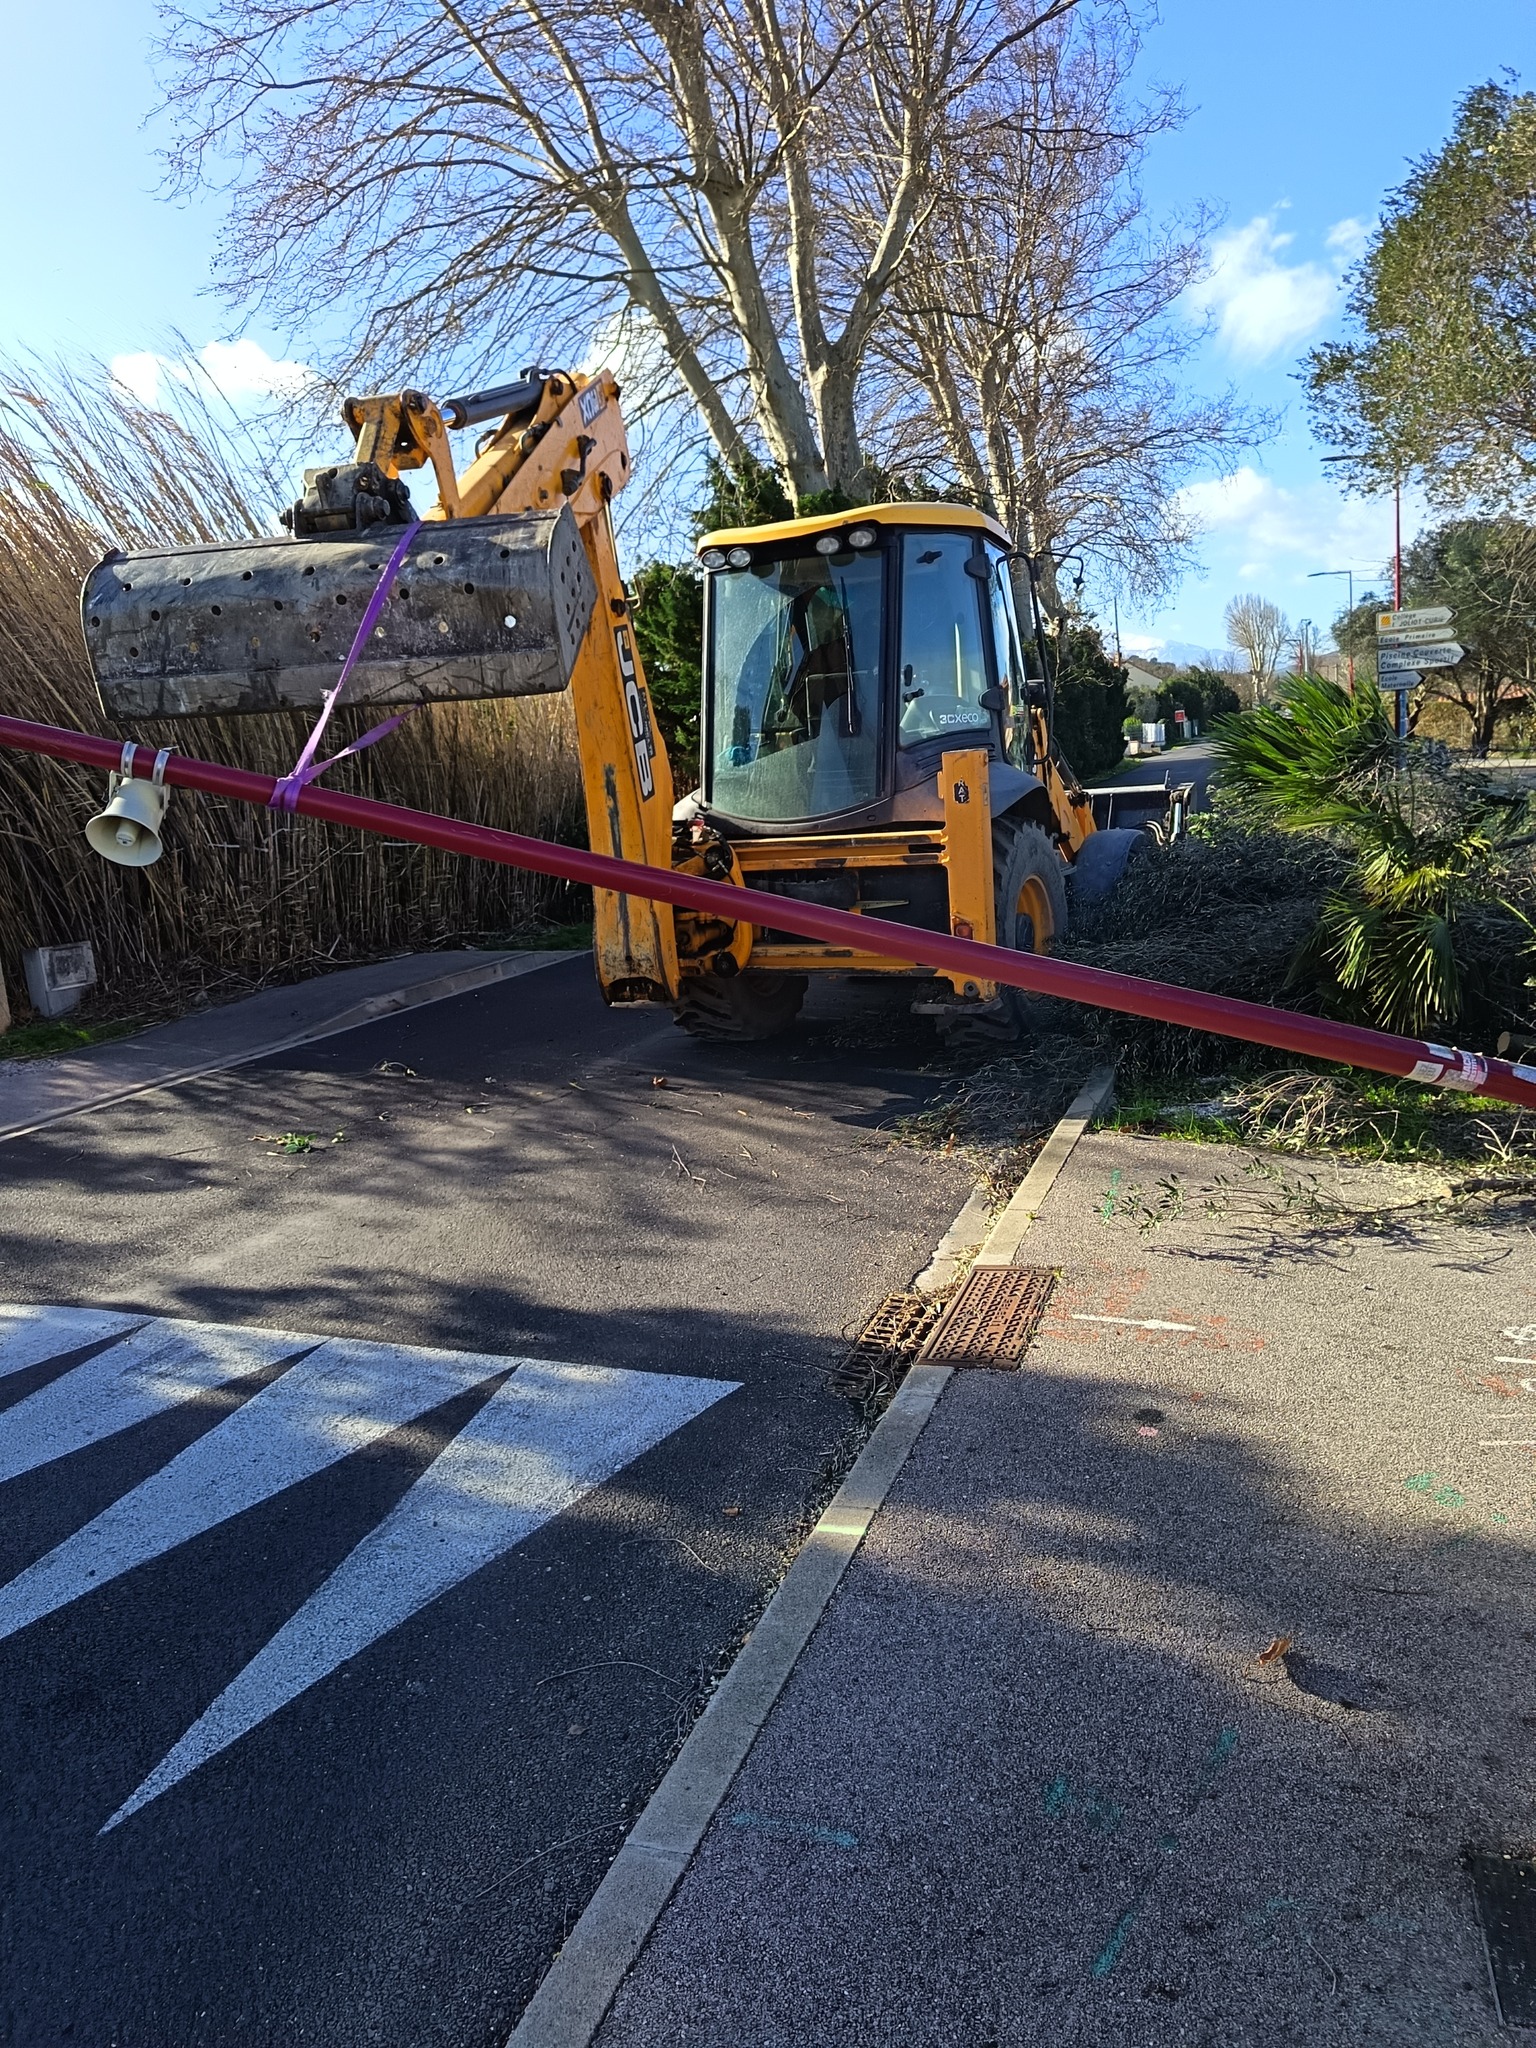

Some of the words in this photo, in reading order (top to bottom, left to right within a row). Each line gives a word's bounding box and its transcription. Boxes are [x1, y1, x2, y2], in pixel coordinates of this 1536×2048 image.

[1404, 632, 1436, 640] Primaire
[1381, 651, 1411, 660] Piscine
[1413, 647, 1452, 657] Couverte
[1380, 660, 1420, 669] Complexe
[1424, 655, 1454, 666] Sportif
[1381, 681, 1414, 689] Maternelle
[616, 630, 653, 797] JCB
